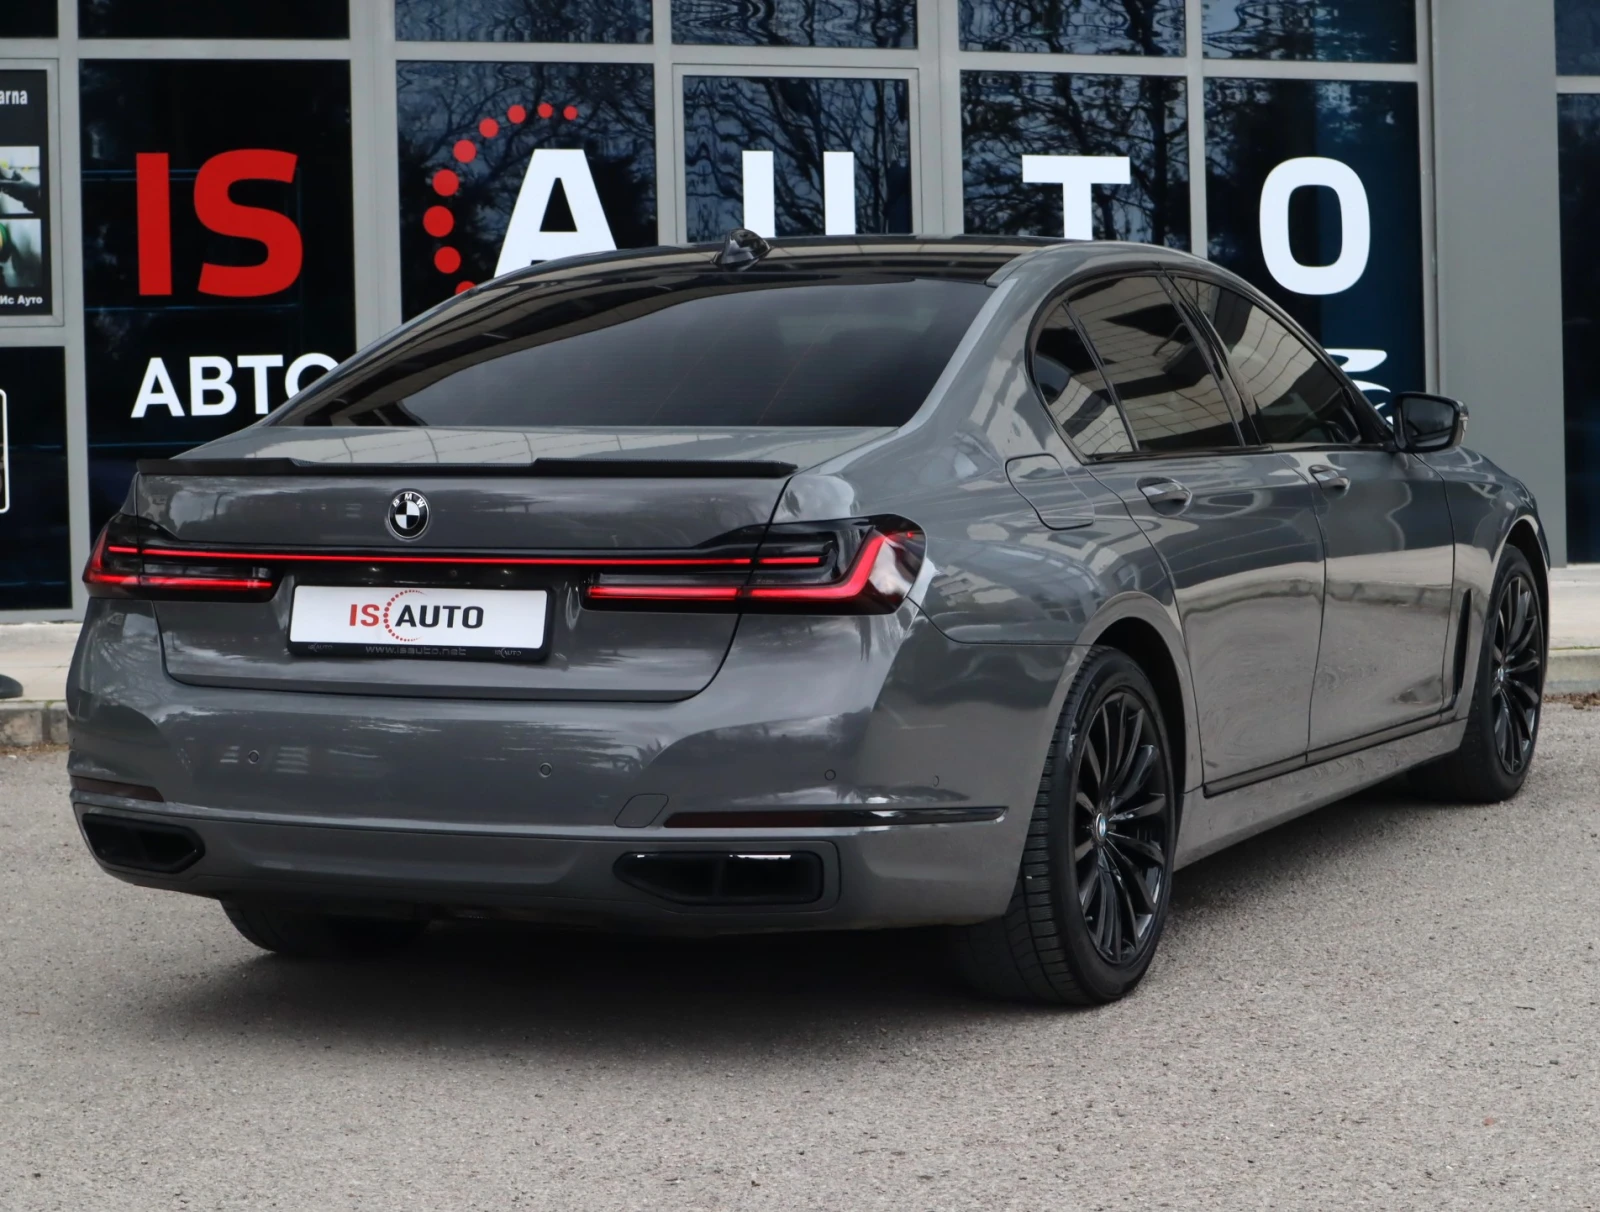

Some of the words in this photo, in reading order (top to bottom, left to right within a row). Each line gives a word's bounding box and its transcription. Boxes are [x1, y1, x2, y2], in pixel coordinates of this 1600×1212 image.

[135, 148, 304, 297] IS
[17, 294, 44, 307] Ауто
[392, 493, 426, 508] BMW
[349, 604, 380, 627] IS
[395, 605, 484, 629] AUTO
[365, 645, 467, 656] www.isauto.net
